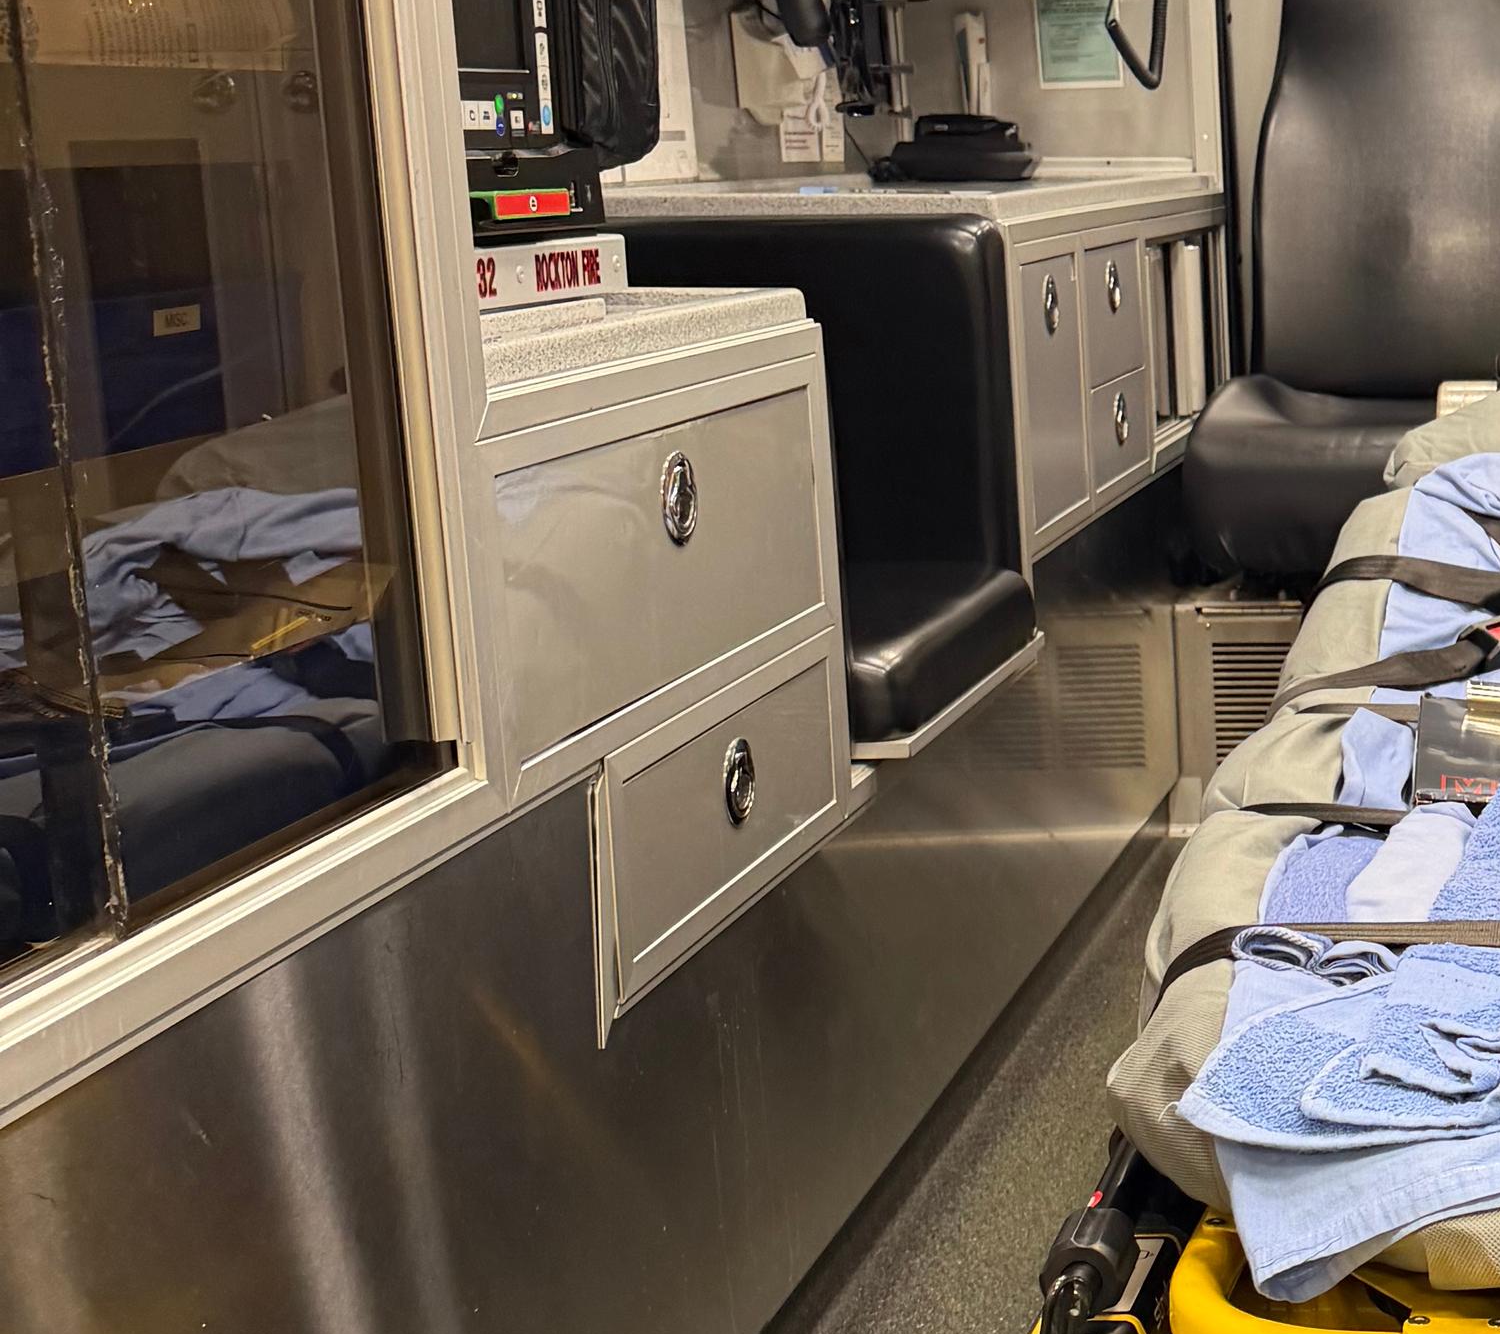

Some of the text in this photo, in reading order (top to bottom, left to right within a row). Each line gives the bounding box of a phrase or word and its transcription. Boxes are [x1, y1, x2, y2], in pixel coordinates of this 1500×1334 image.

[477, 248, 602, 299] 32 ROCKTON FIRE
